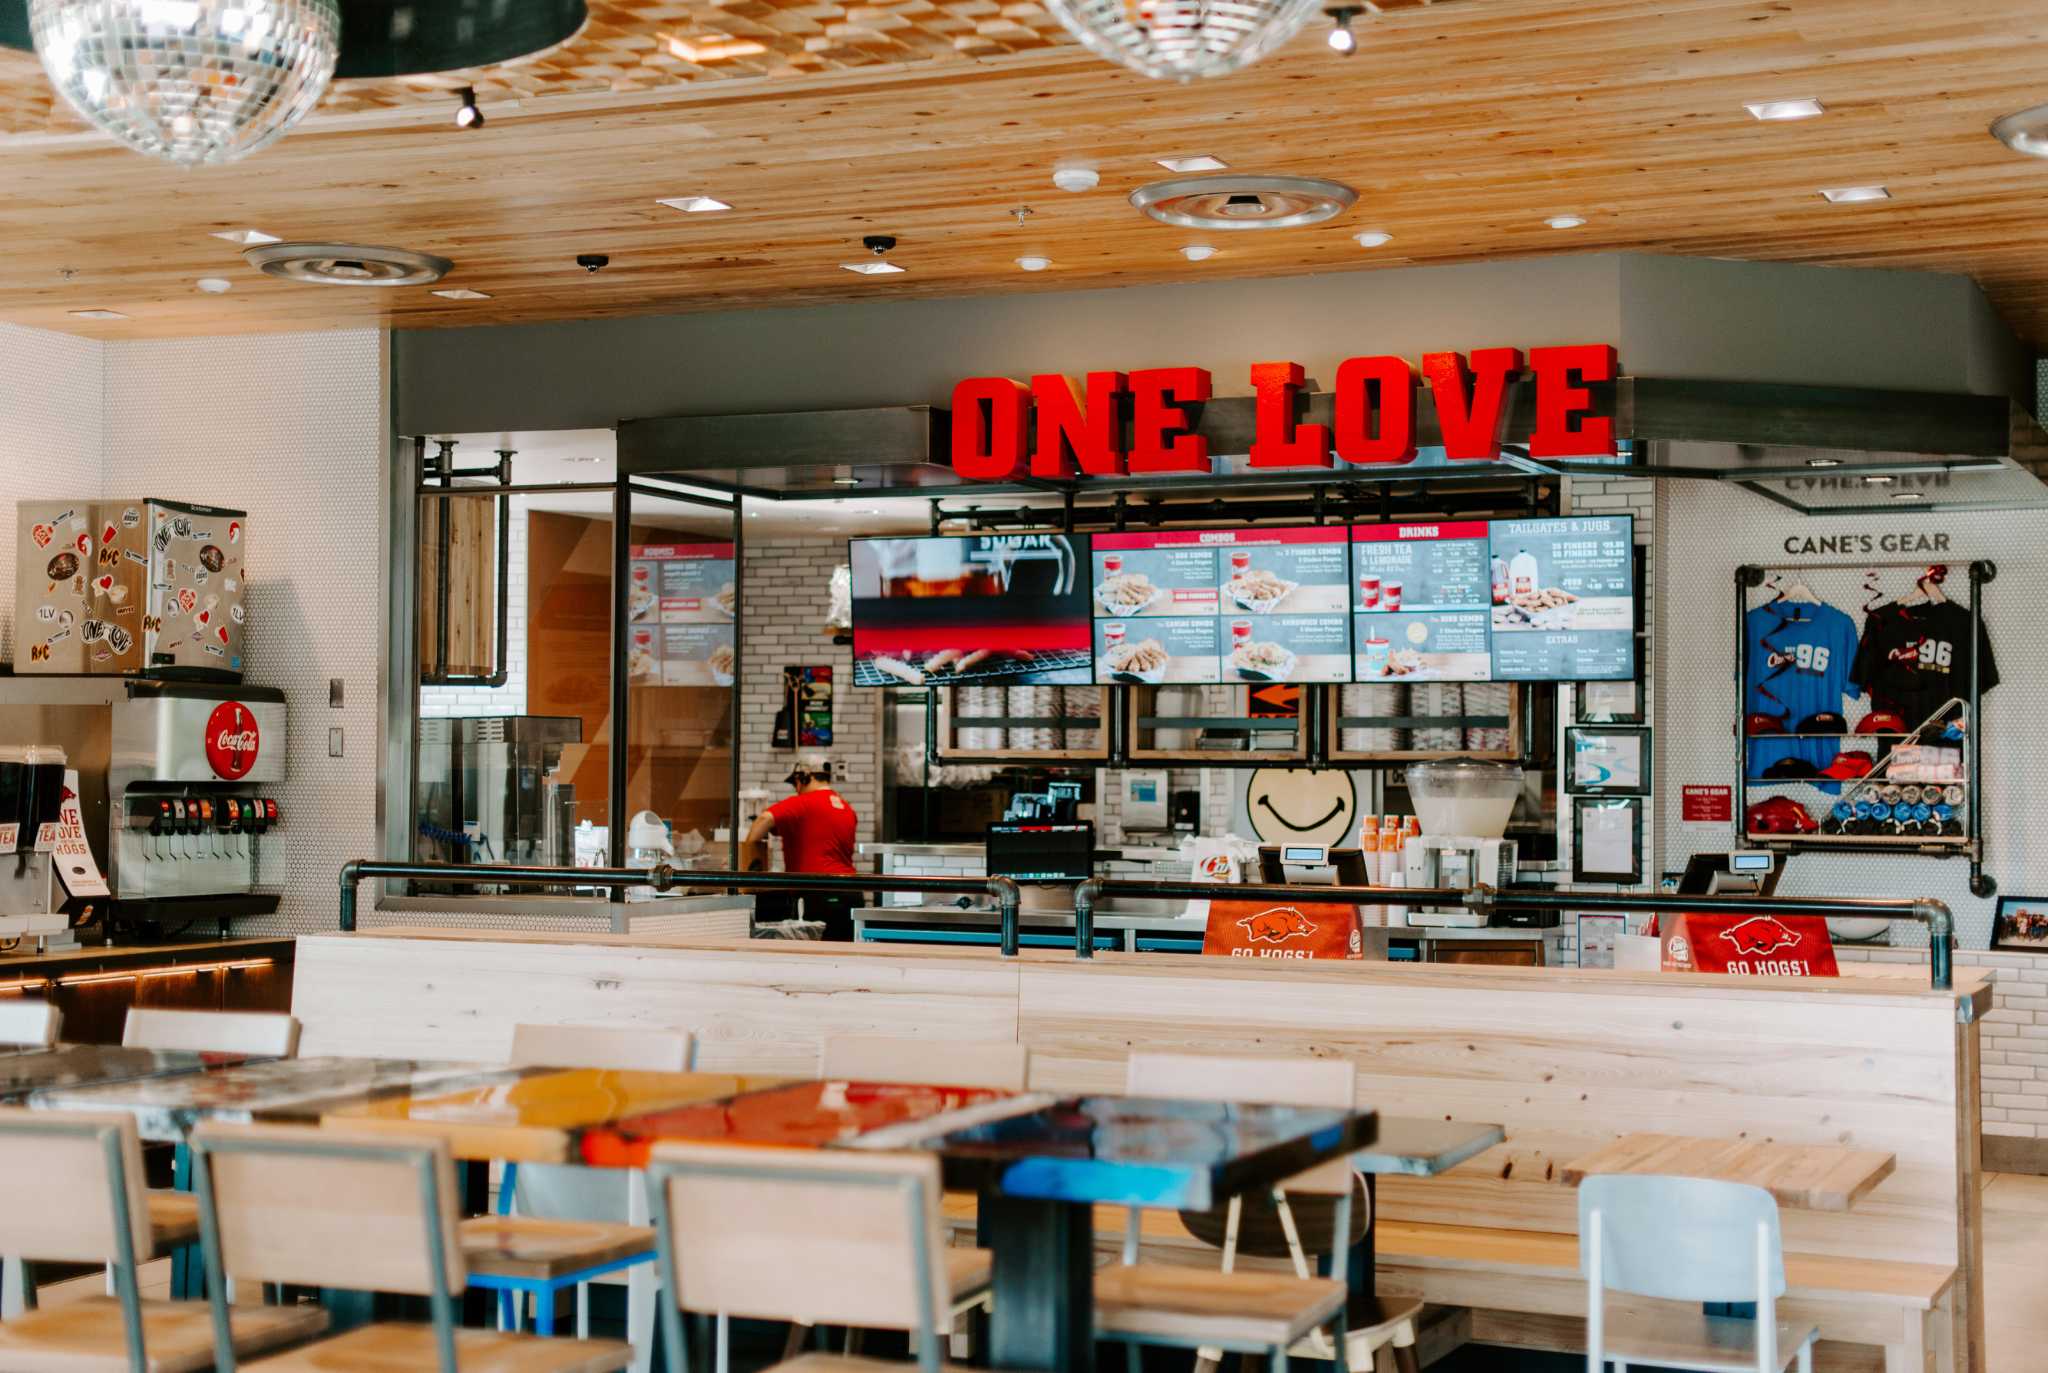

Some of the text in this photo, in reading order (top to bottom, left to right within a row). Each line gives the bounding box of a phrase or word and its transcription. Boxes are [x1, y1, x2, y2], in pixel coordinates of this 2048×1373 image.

[952, 344, 1619, 482] ONE LOVE
[1399, 526, 1439, 538] DRINKS
[1510, 522, 1567, 534] TAILGATES
[1583, 520, 1610, 532] JUGS
[1361, 543, 1412, 555] FRESH TEA
[1784, 533, 1950, 554] CANE'S GEAR
[82, 620, 133, 652] ONE LOVE
[1796, 643, 1830, 672] 96
[1918, 638, 1953, 667] 96
[217, 729, 257, 752] Coca-Cola
[39, 830, 56, 842] TEA
[1727, 960, 1811, 976] GO HOGS!
